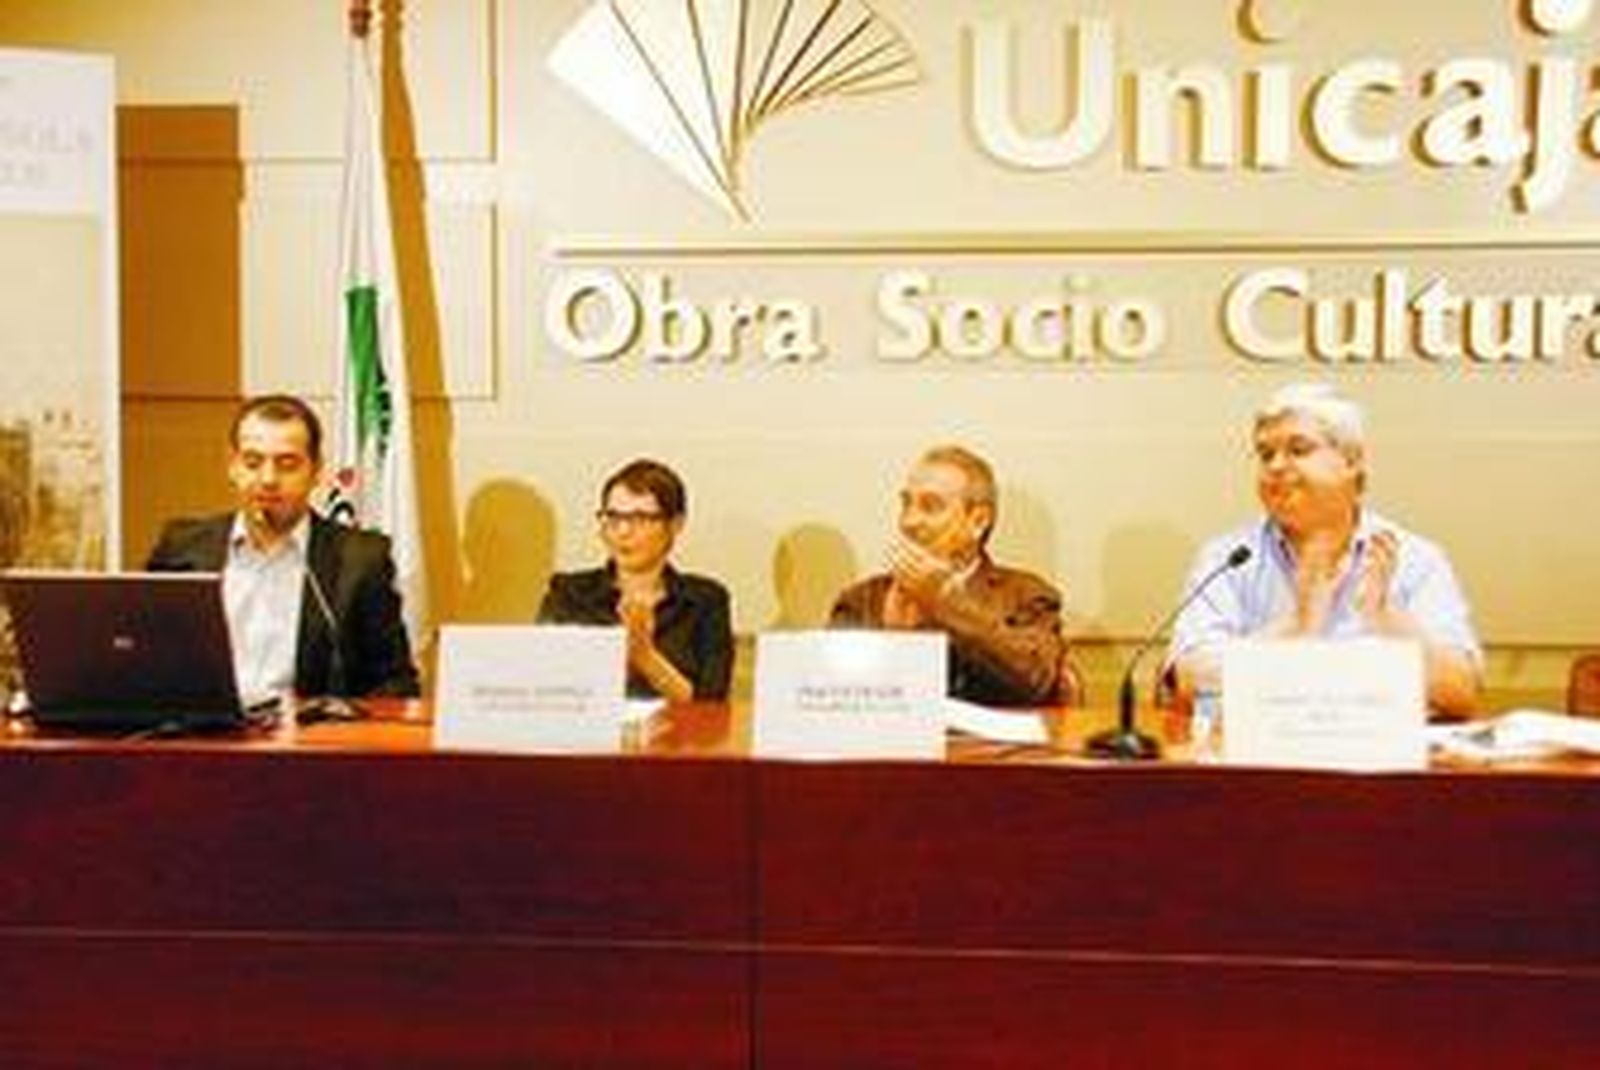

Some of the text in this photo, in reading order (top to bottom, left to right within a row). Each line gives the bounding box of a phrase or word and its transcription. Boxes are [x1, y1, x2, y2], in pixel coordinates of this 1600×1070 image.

[966, 0, 1600, 213] Unicaj
[545, 267, 1600, 364] Obra Socio Cultur
